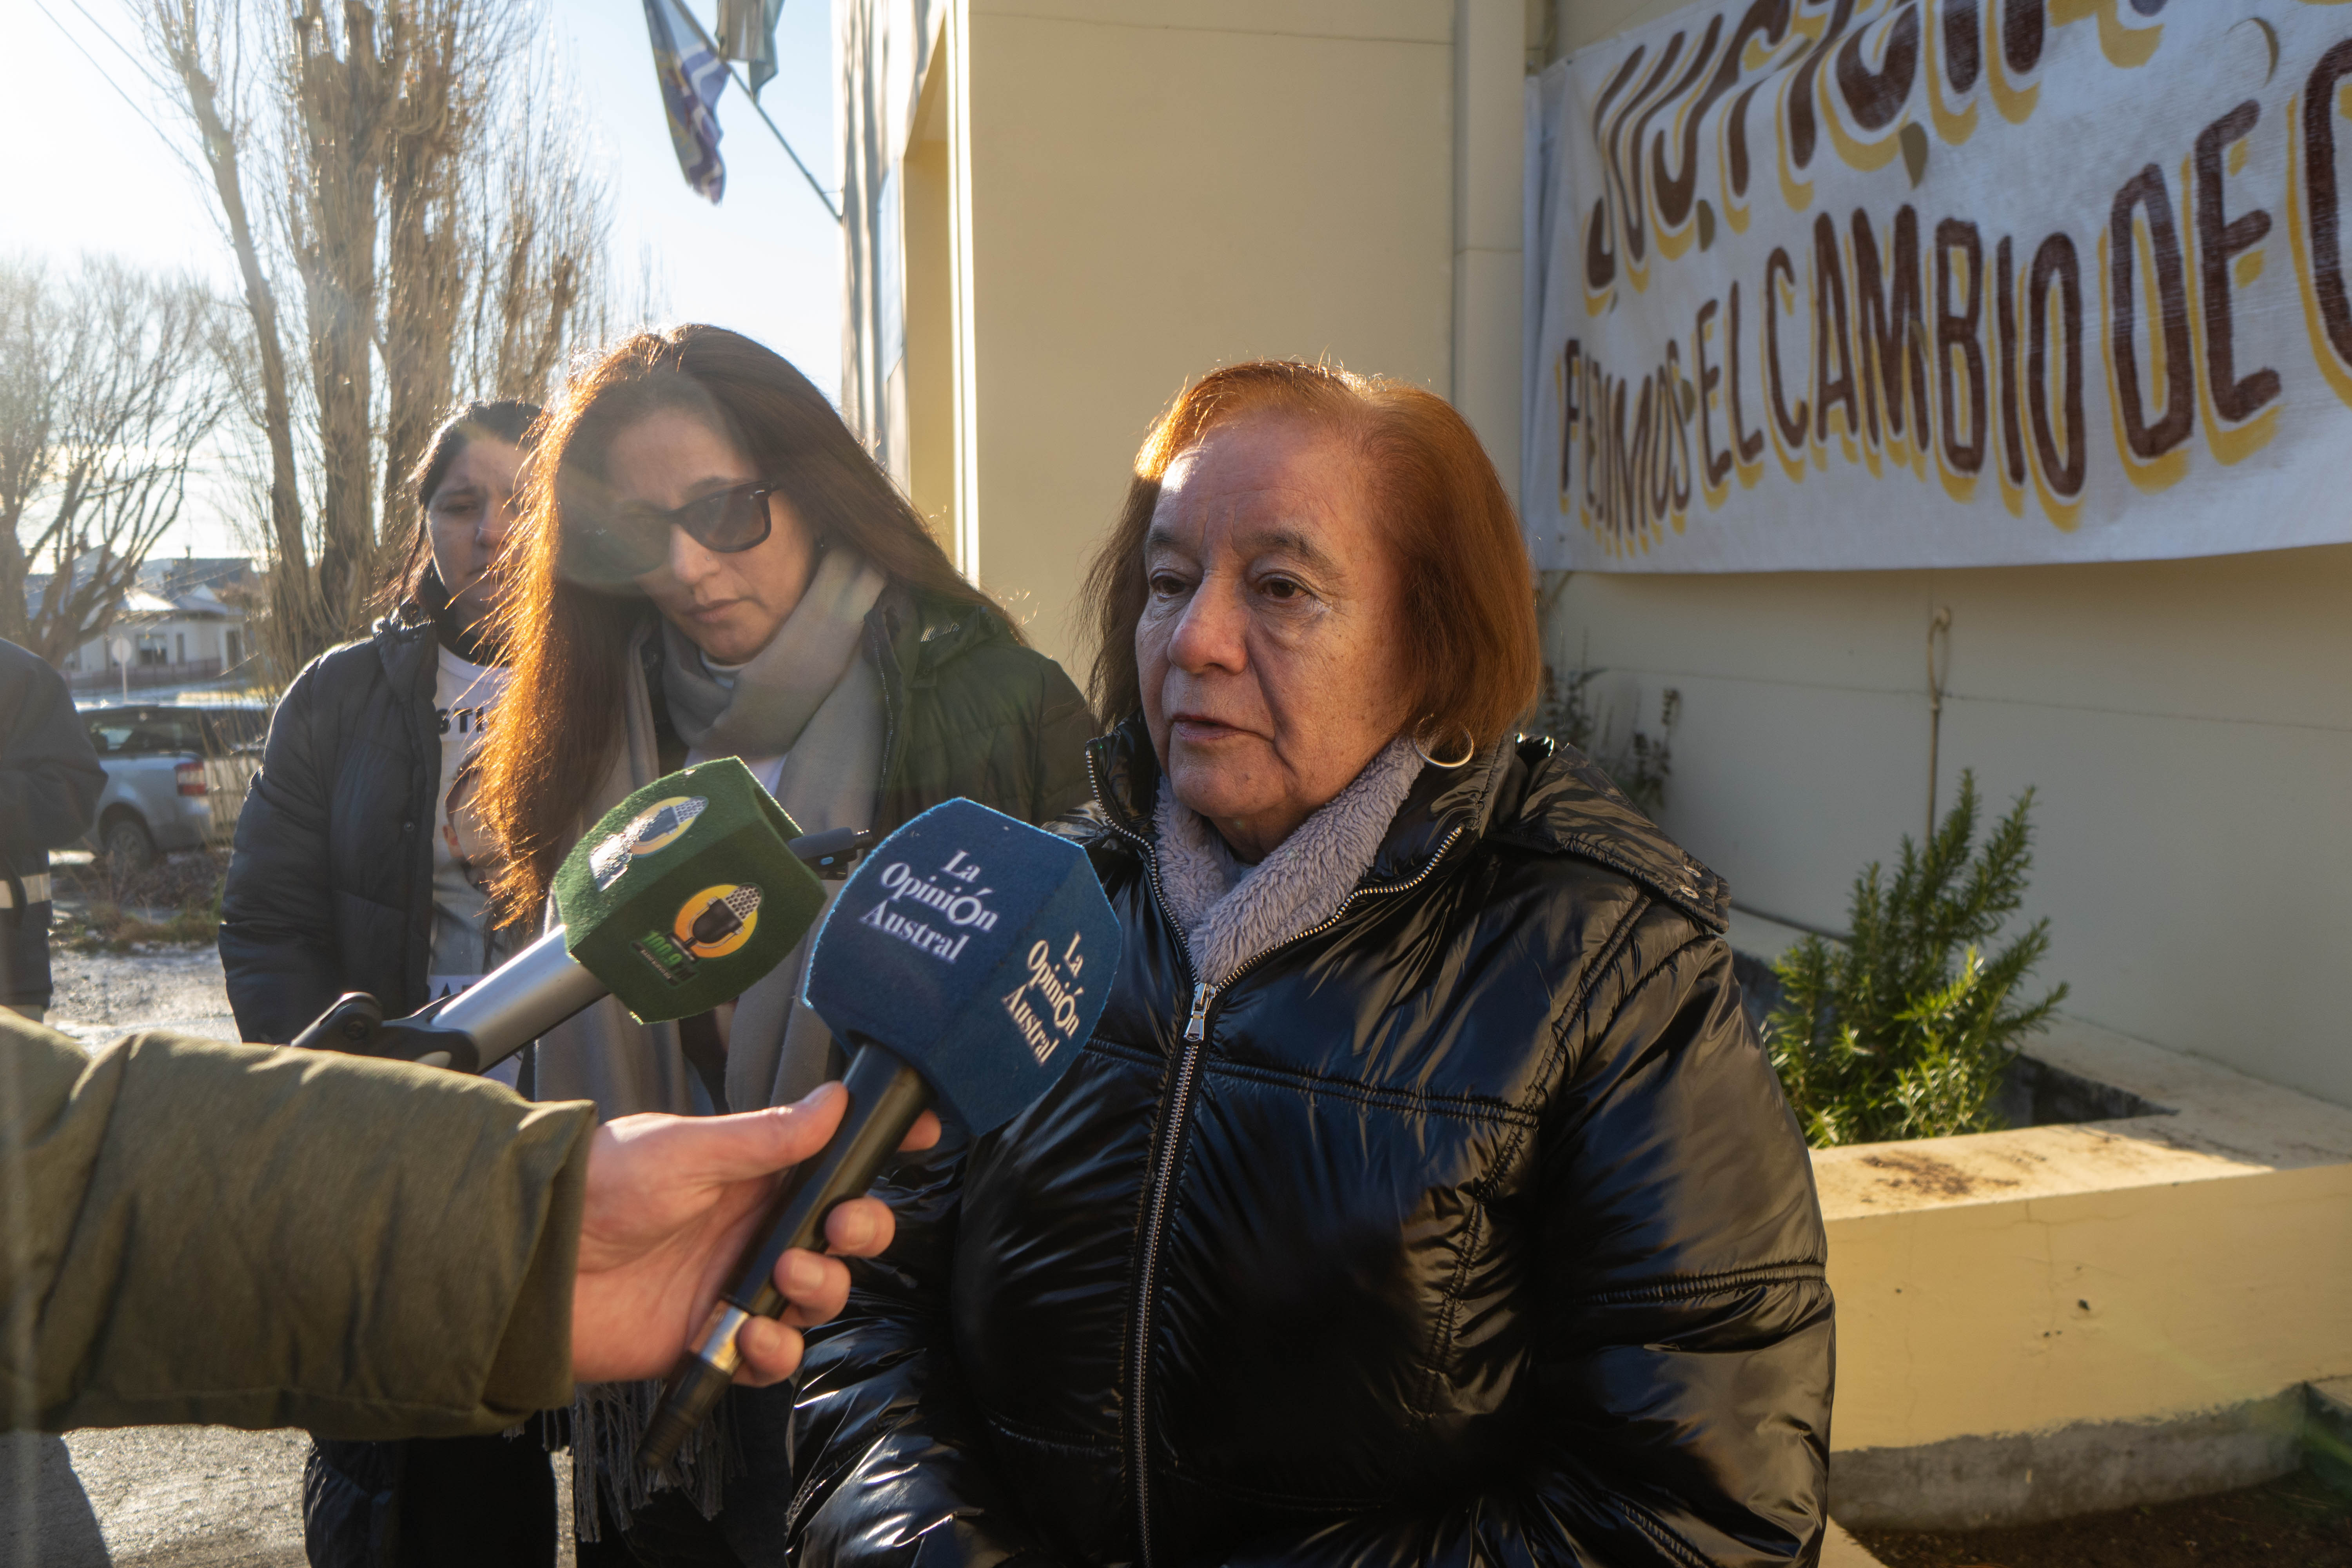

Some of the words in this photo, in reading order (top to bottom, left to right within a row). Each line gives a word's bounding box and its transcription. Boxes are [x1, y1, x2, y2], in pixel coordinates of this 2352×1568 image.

[1695, 279, 1765, 487] EL
[1765, 203, 2087, 497] CAMBIO
[2111, 99, 2281, 459] DE
[940, 849, 982, 883] La
[642, 931, 683, 966] 100.9
[860, 899, 971, 964] Austral
[1063, 931, 1083, 978] La
[640, 949, 654, 962] RADIO
[1001, 984, 1060, 1067] Austral
